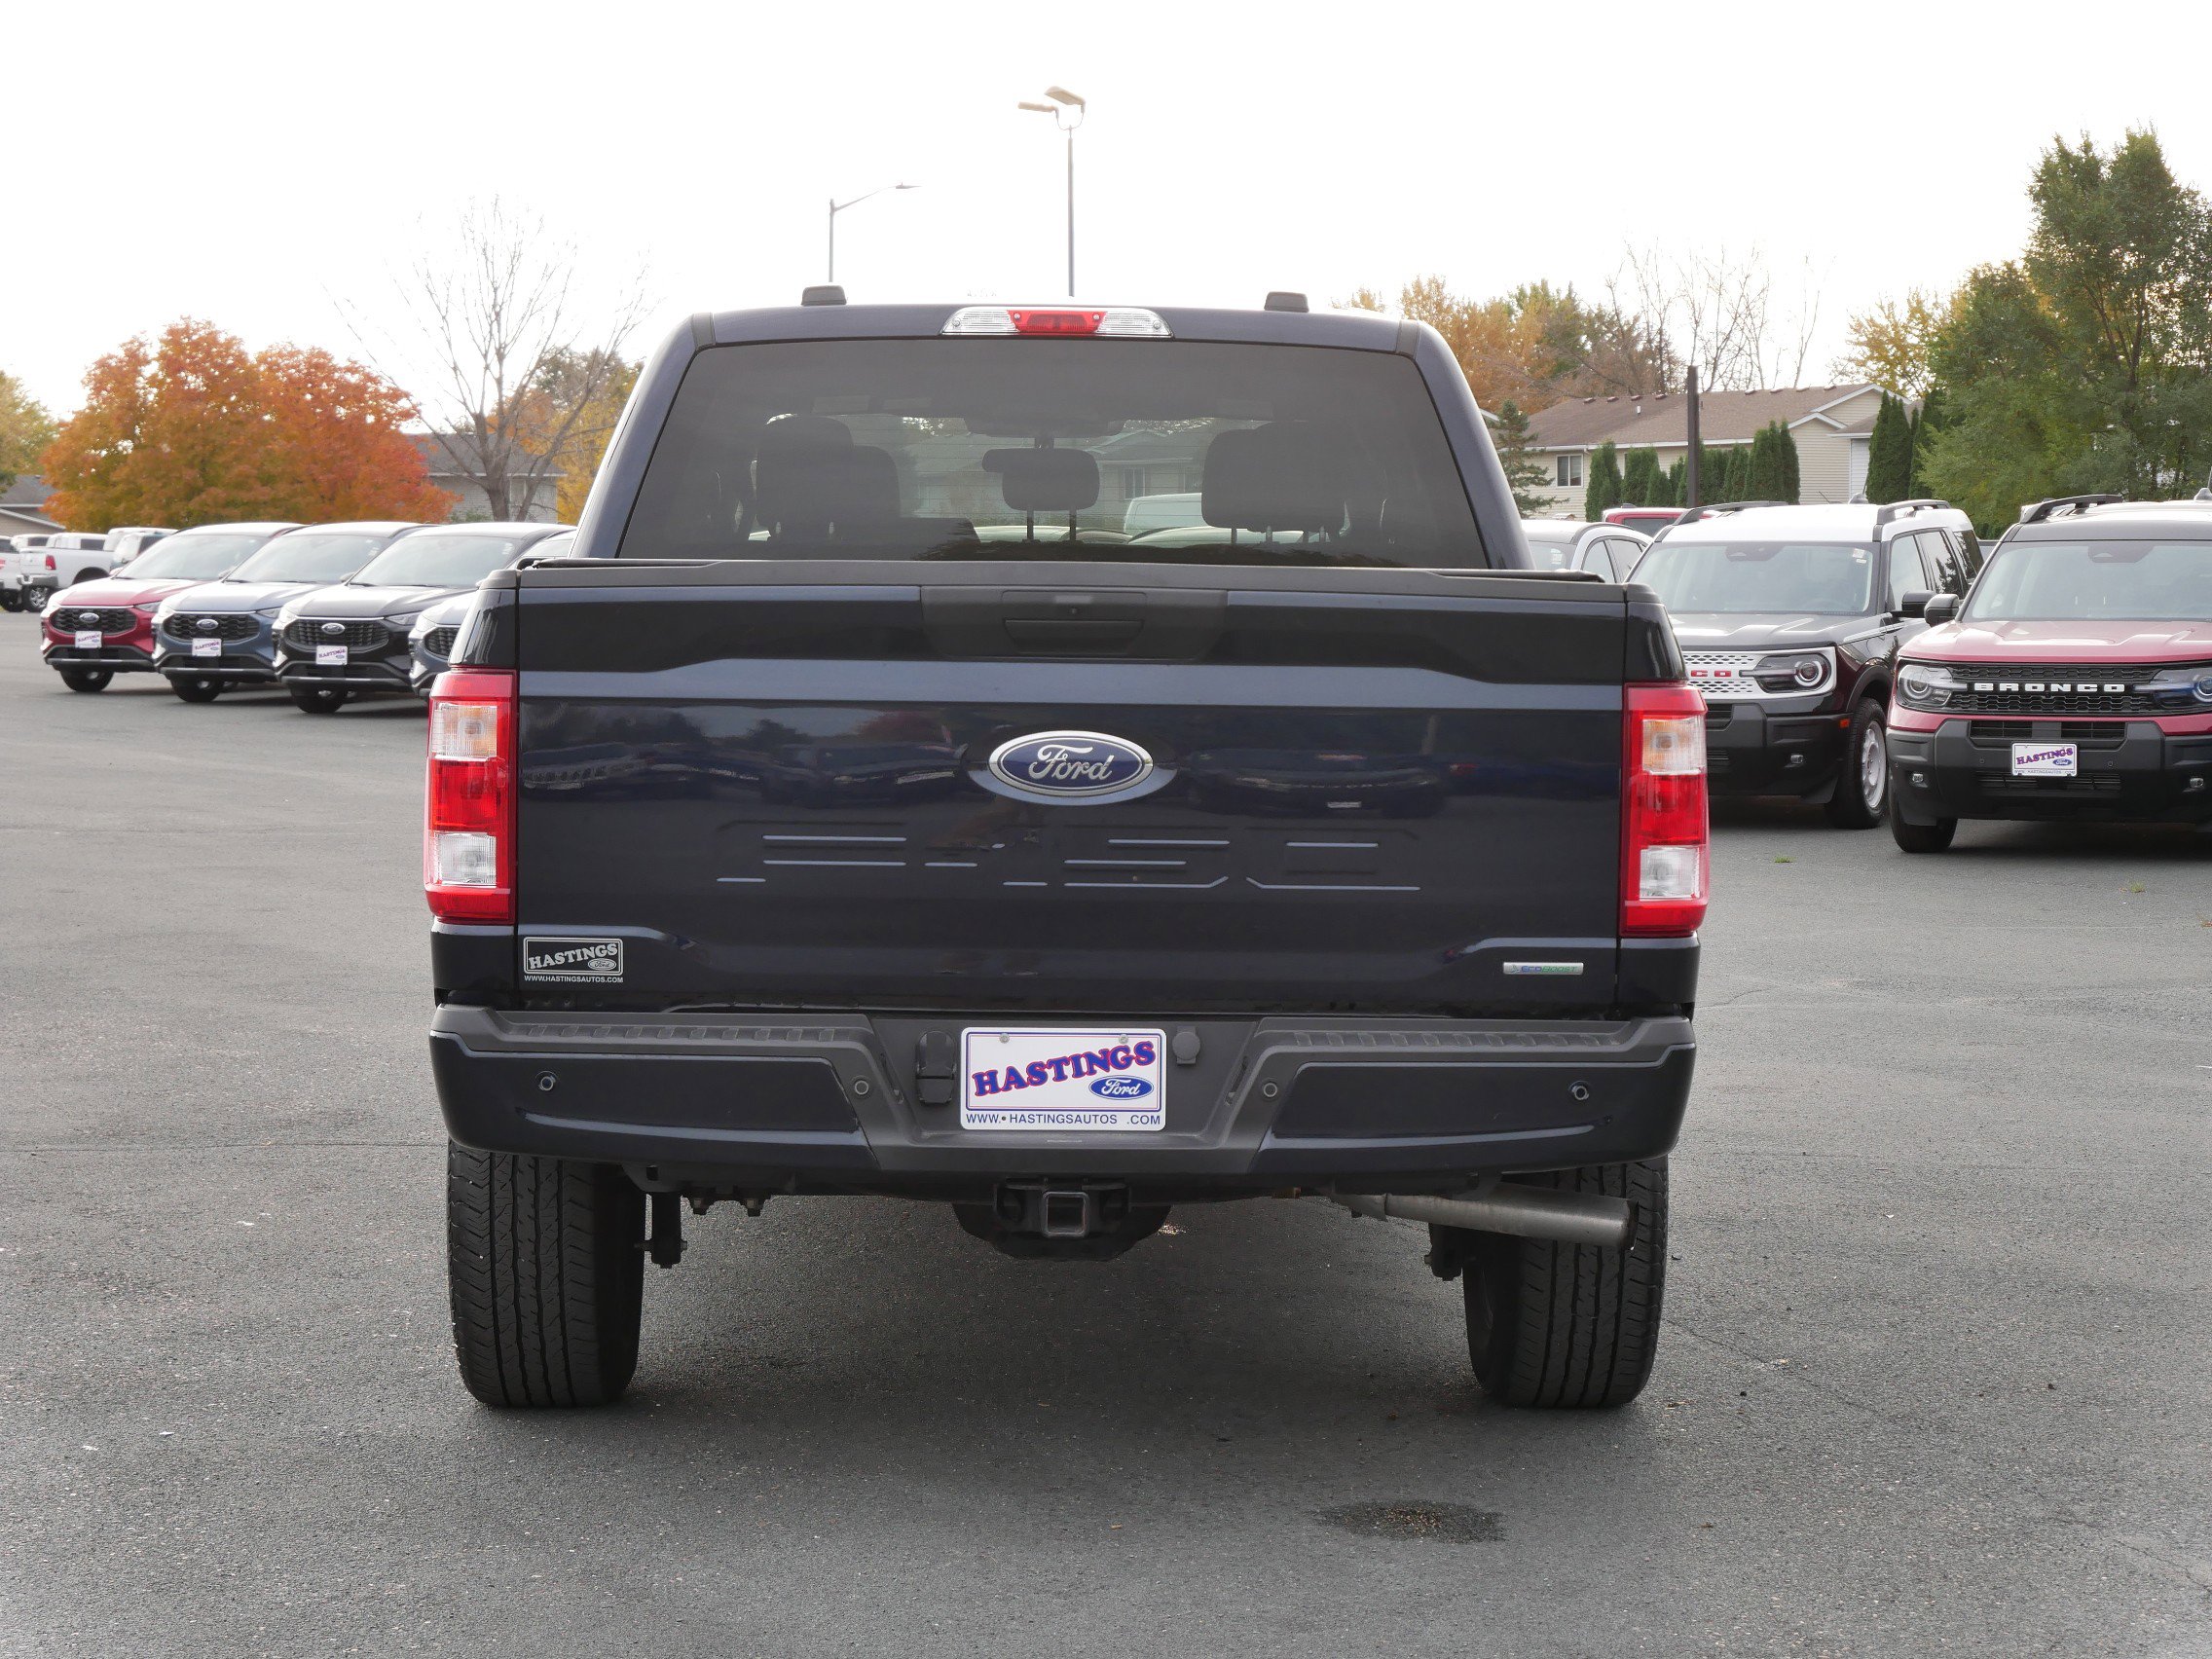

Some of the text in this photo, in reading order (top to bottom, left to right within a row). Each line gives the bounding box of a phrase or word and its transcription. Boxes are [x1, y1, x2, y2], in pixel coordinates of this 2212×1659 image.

[1973, 682, 2125, 692] BRONCO
[1028, 744, 1115, 781] Ford
[2016, 748, 2074, 765] HASTINGS
[528, 942, 618, 970] HASTINGS
[524, 975, 624, 983] WWW.HASTINGSAUTOS.COM
[972, 1040, 1157, 1097] HASTINGS
[1100, 1078, 1141, 1095] Ford
[1009, 1114, 1118, 1124] HASTINGSAUTOS
